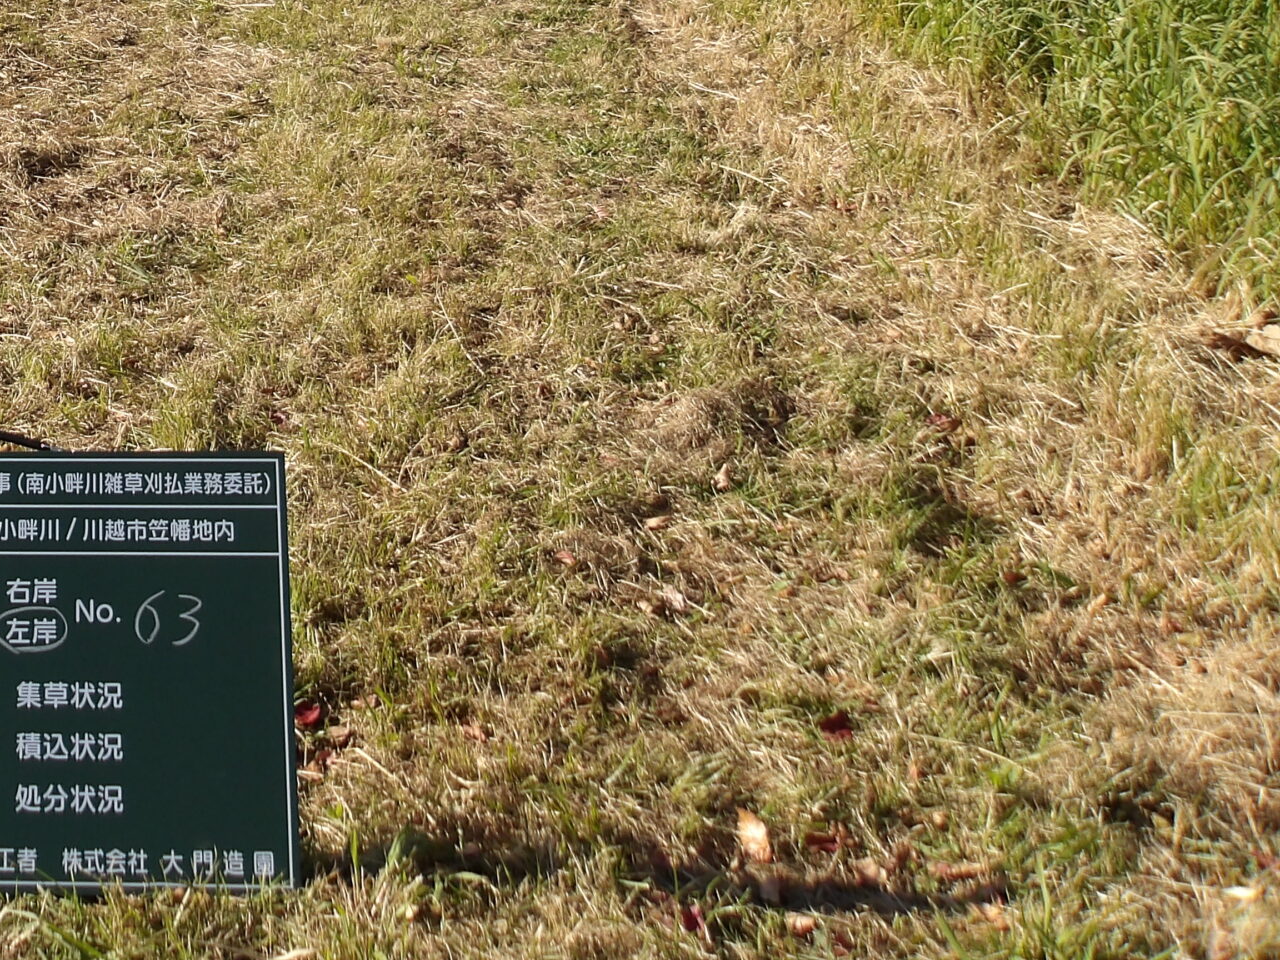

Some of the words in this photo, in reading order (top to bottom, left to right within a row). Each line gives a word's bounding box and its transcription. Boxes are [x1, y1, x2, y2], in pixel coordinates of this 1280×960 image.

[6, 578, 57, 604] 右岸
[6, 618, 57, 645] 左岸
[75, 599, 121, 623] No.
[135, 590, 202, 645] 63
[16, 681, 123, 709] 集草状況
[16, 732, 123, 760] 積込状況
[15, 784, 123, 813] 処分状況
